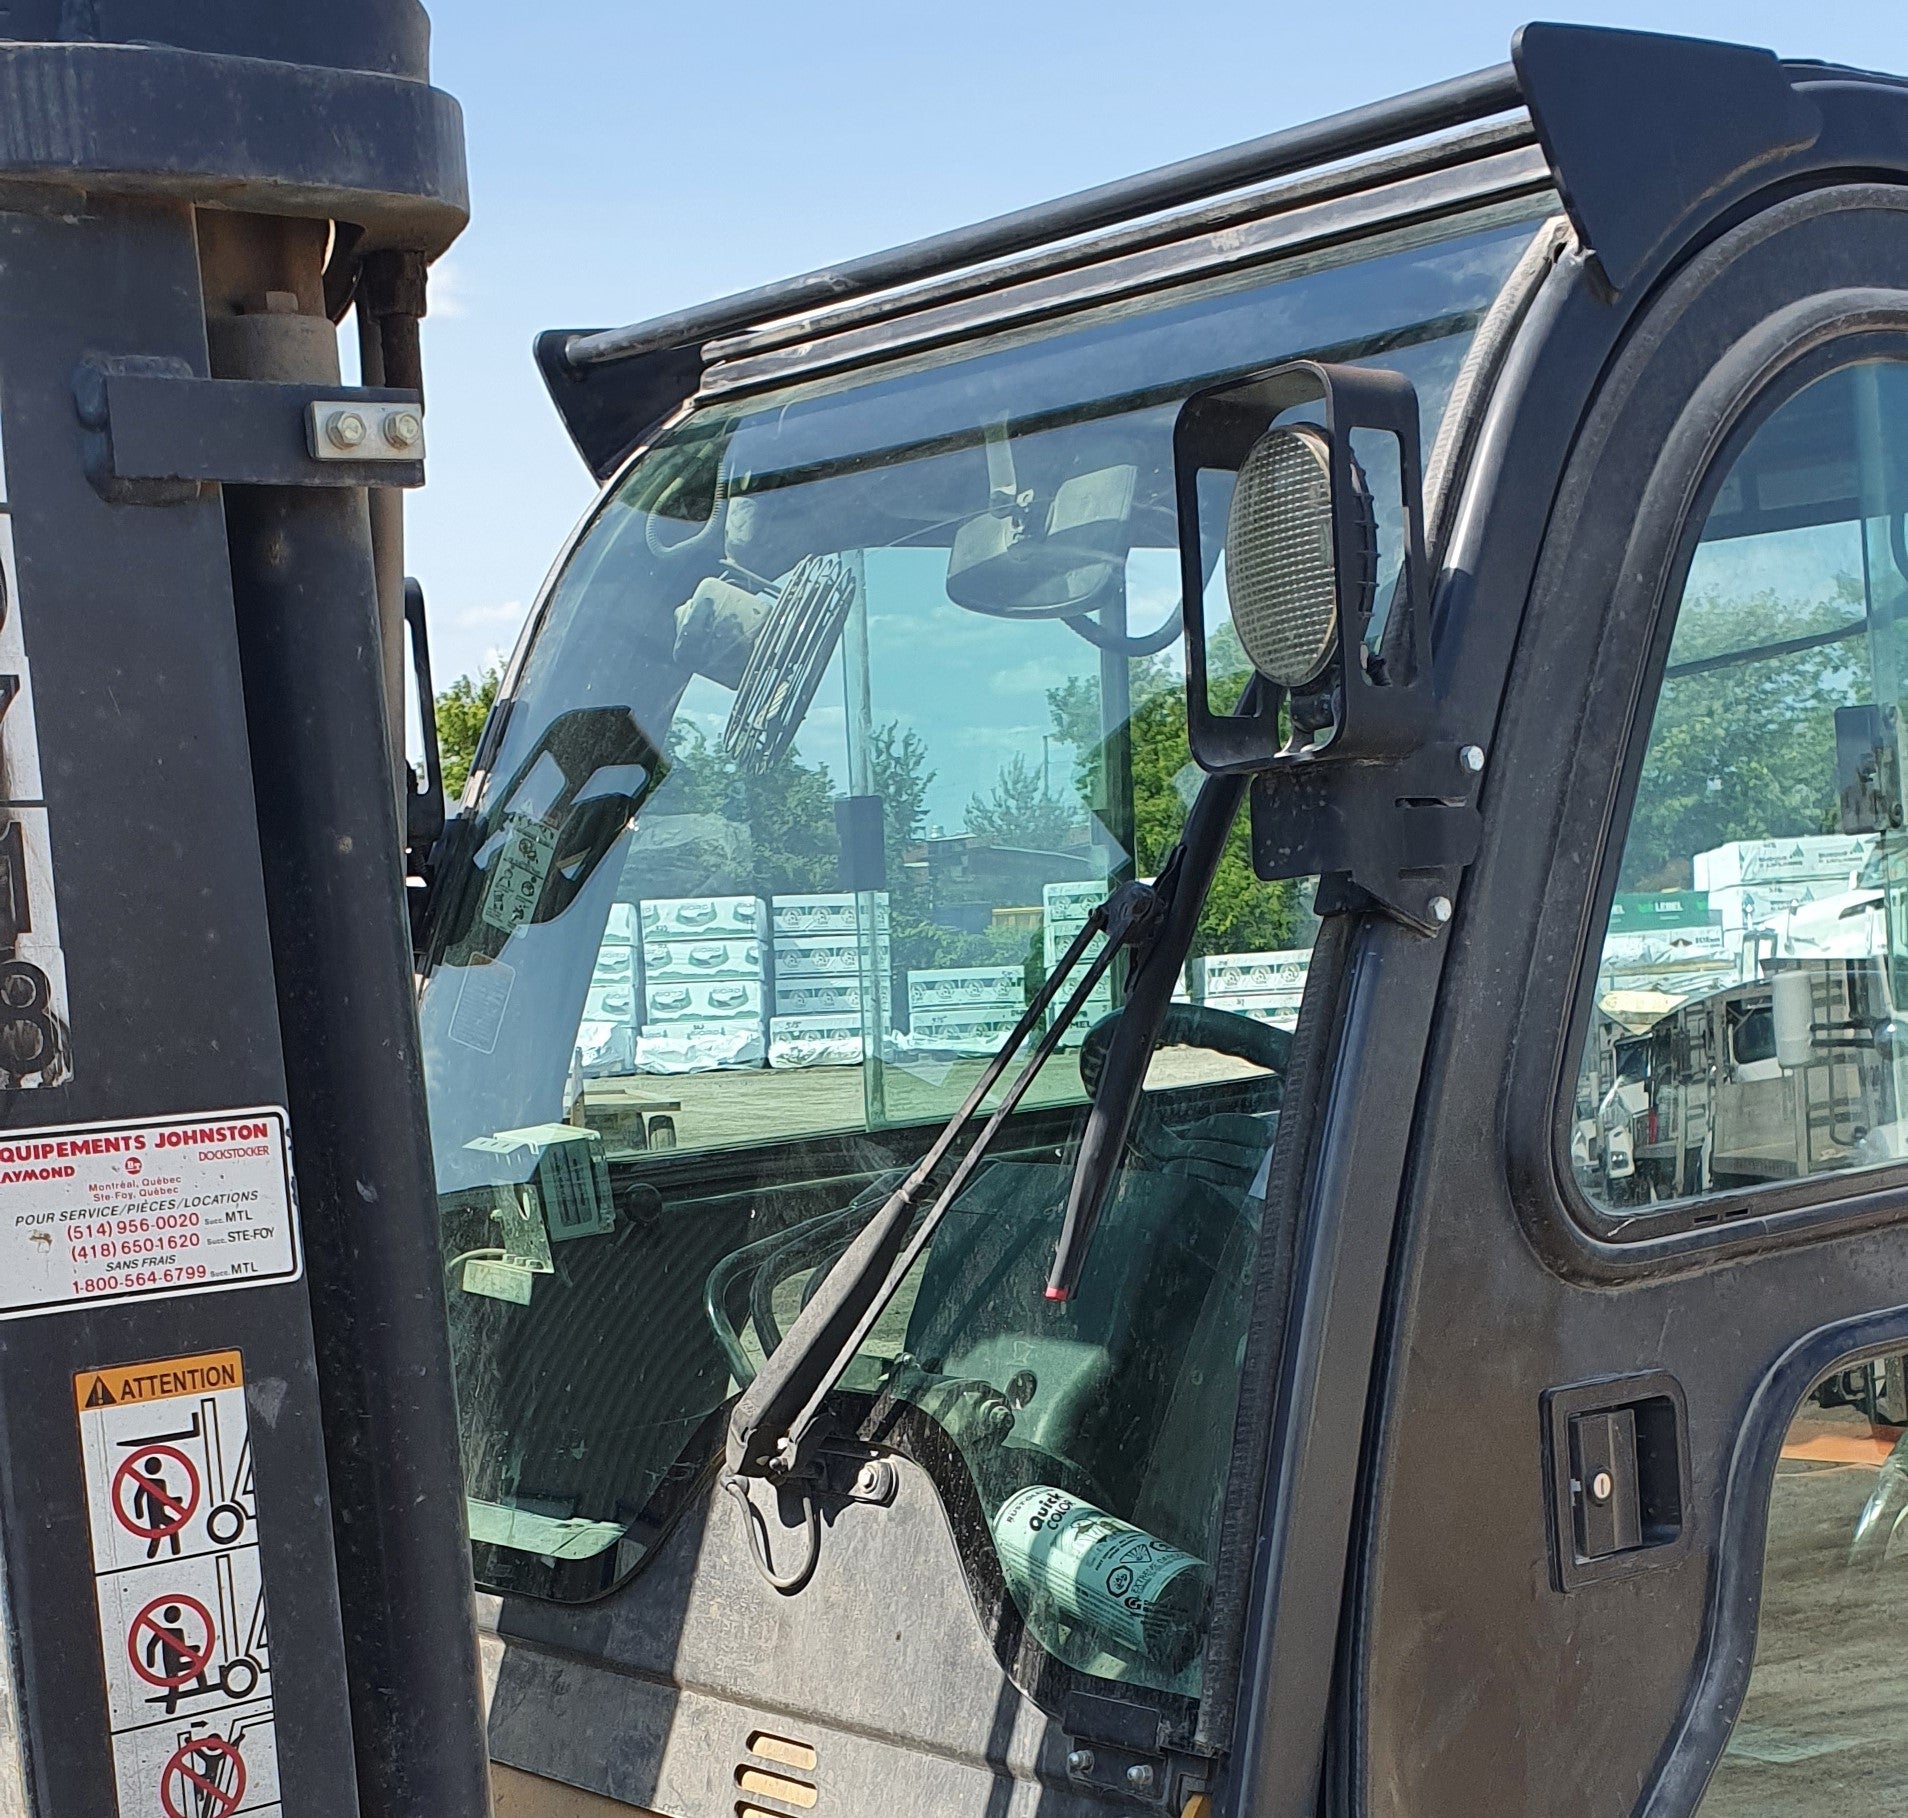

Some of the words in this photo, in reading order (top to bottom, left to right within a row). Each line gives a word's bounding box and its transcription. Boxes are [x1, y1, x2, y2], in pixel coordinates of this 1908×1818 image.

[154, 1123, 268, 1149] JOHNSTON
[198, 1146, 270, 1162] DOCKSTOCKER
[138, 1186, 179, 1197] Québec
[141, 1176, 182, 1187] Québec
[15, 1212, 55, 1227] POUR
[58, 1190, 259, 1222] SERVICE/PIÈCES/LOCATIONS
[67, 1220, 112, 1242] (514)
[116, 1212, 200, 1235] 956-0020
[225, 1210, 253, 1223] MTL
[71, 1240, 117, 1263] (418)
[121, 1232, 200, 1255] 650-1620
[227, 1226, 275, 1243] STE-FOY
[72, 1264, 207, 1295] 1-800-564-6799
[231, 1262, 259, 1275] MTL
[105, 1261, 139, 1273] SANS
[141, 1255, 176, 1268] FRAIS
[120, 1363, 236, 1401] ATTENTION
[1029, 1492, 1064, 1532] Quick
